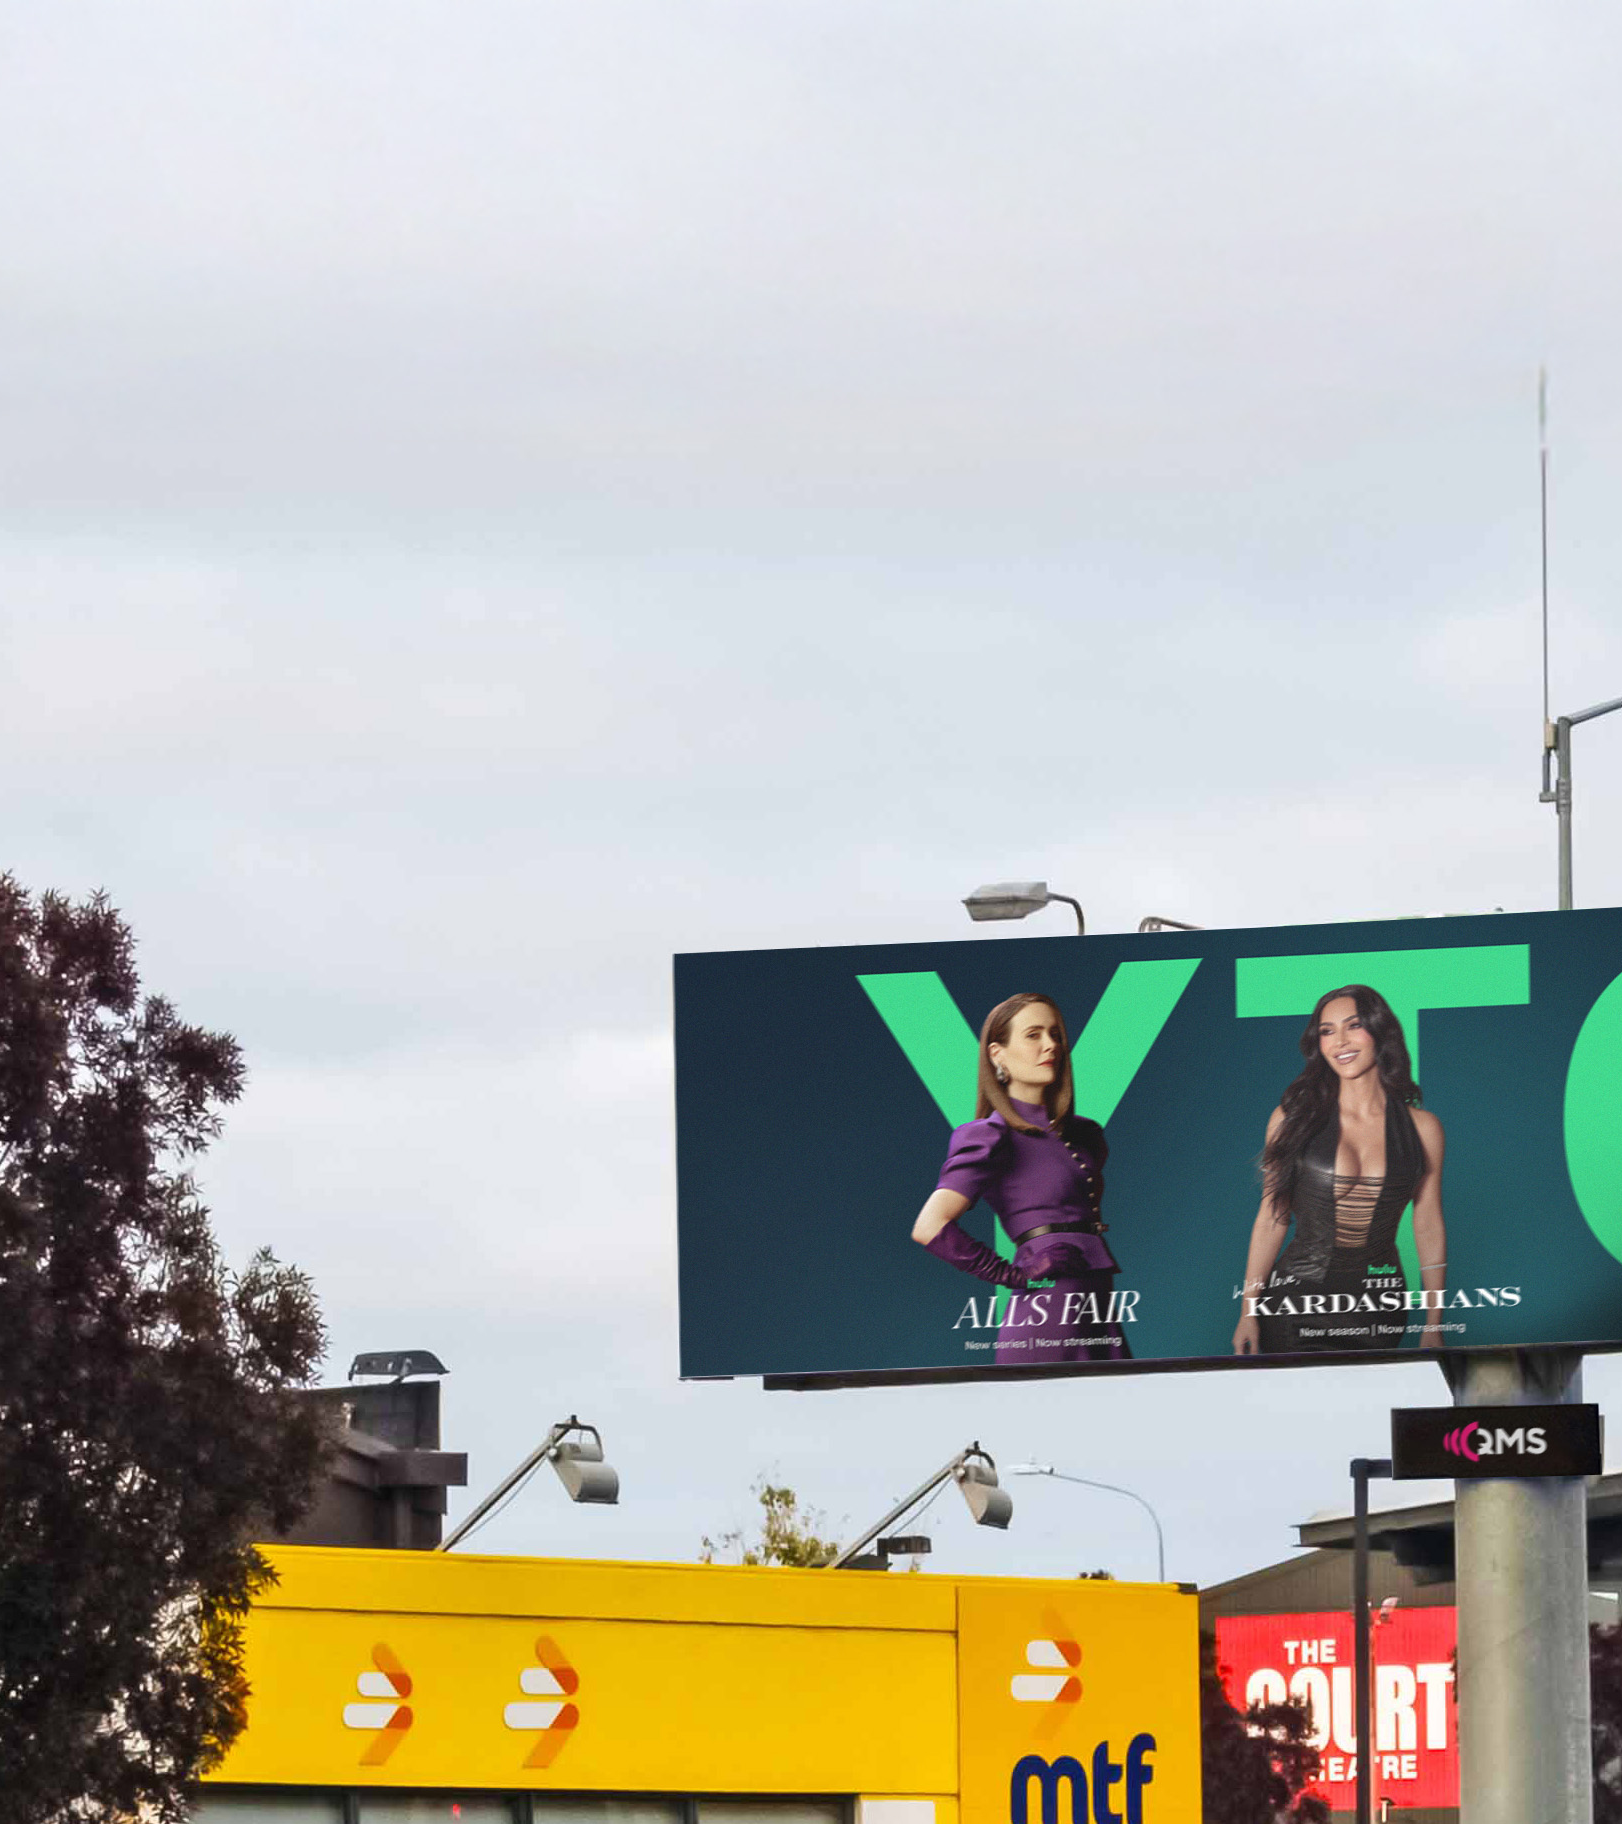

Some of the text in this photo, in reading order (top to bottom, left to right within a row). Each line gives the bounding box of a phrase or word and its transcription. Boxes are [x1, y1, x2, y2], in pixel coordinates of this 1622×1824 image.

[1367, 1264, 1397, 1275] hulu
[1027, 1278, 1056, 1289] hulu
[1362, 1277, 1403, 1289] THE
[951, 1290, 1141, 1329] ALL'S FAIR
[1245, 1286, 1521, 1317] KARDASHIANS
[1299, 1321, 1466, 1337] New season Now streaming
[964, 1336, 1123, 1350] New series Now streaming
[1460, 1421, 1548, 1462] QMS
[1283, 1639, 1337, 1664] THE
